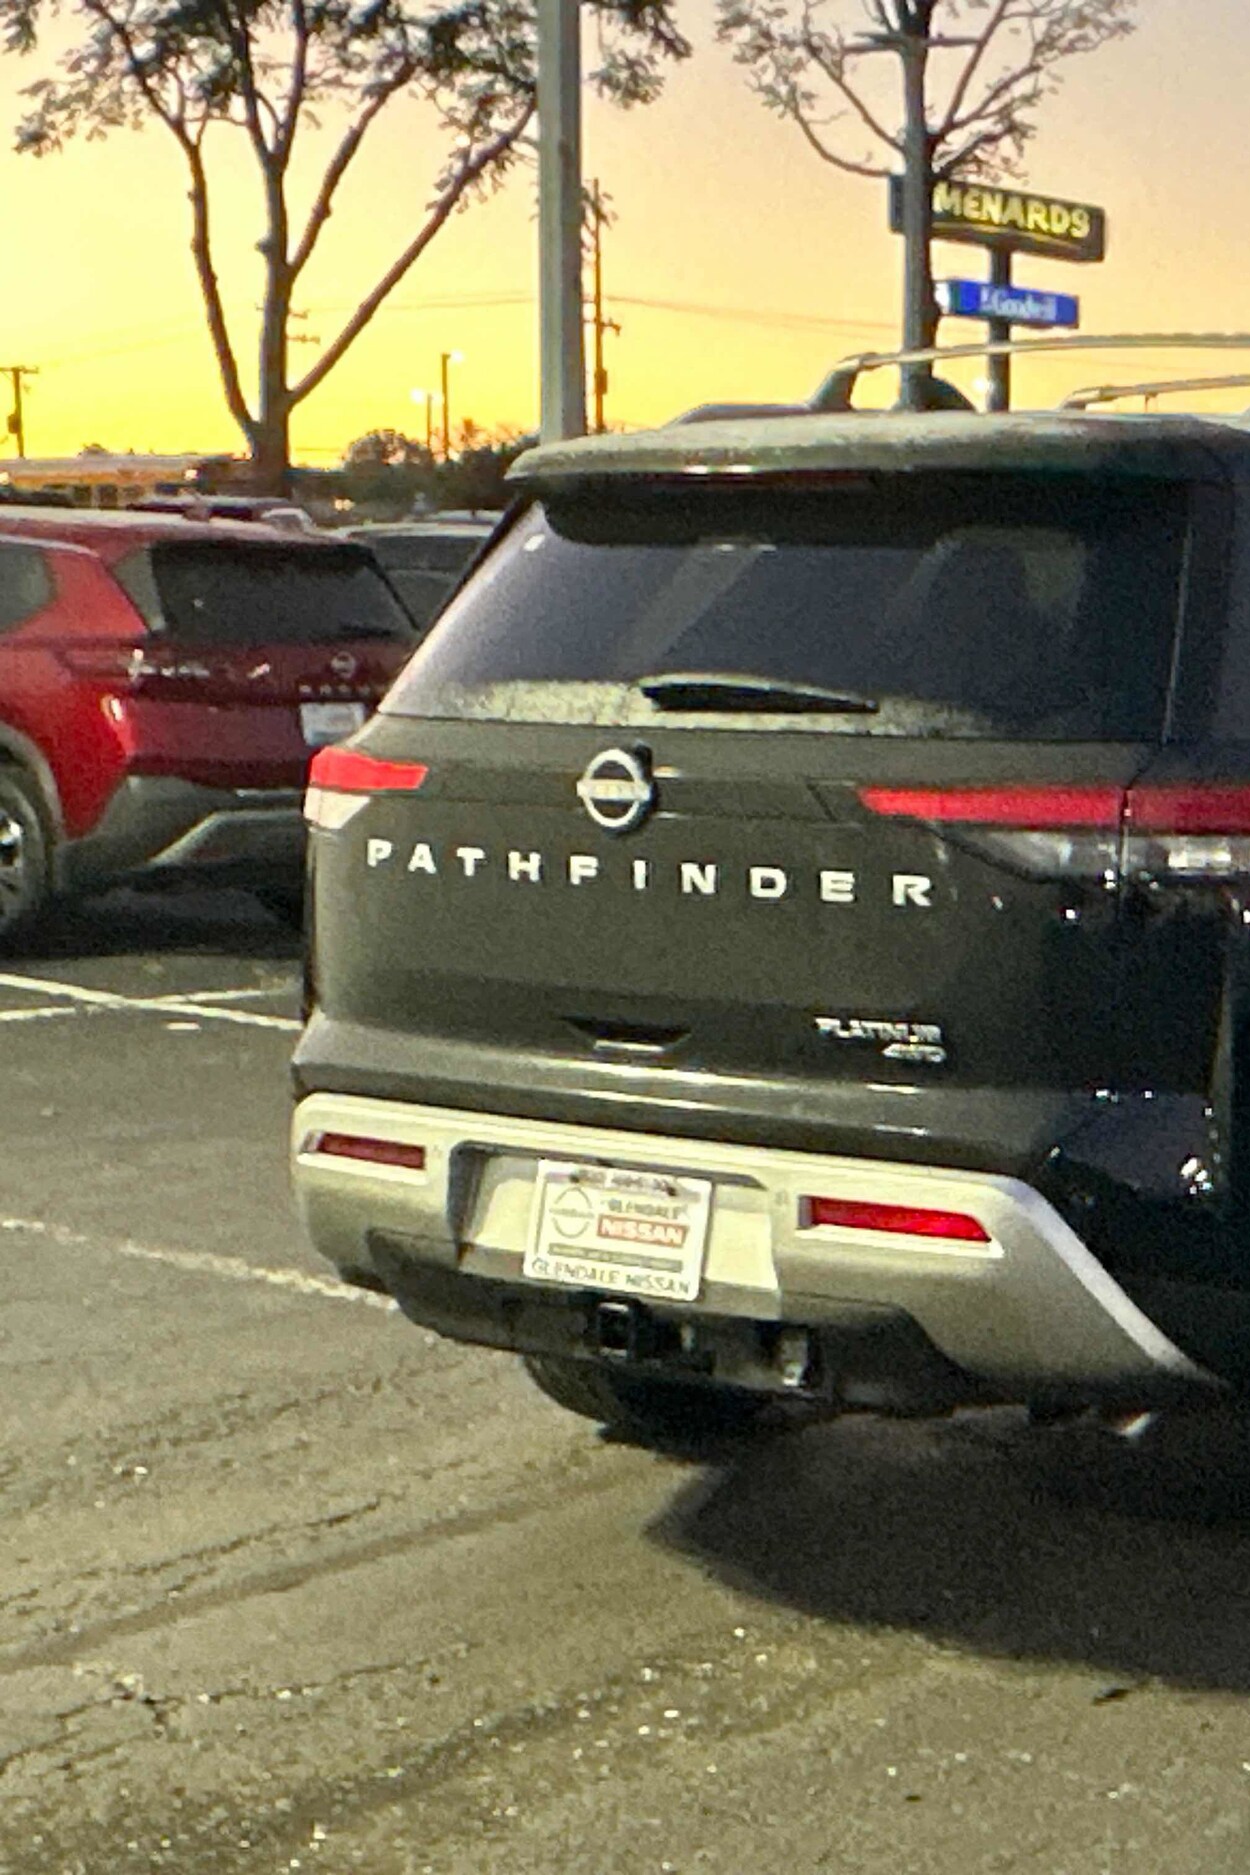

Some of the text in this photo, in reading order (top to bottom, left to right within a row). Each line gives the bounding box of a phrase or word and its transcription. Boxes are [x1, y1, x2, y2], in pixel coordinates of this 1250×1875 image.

[933, 182, 1090, 237] MENARDS
[366, 839, 933, 906] PATHFINDER
[601, 1217, 683, 1246] NISSAN
[532, 1257, 620, 1284] GLENDALE
[626, 1273, 690, 1294] NISSAN
